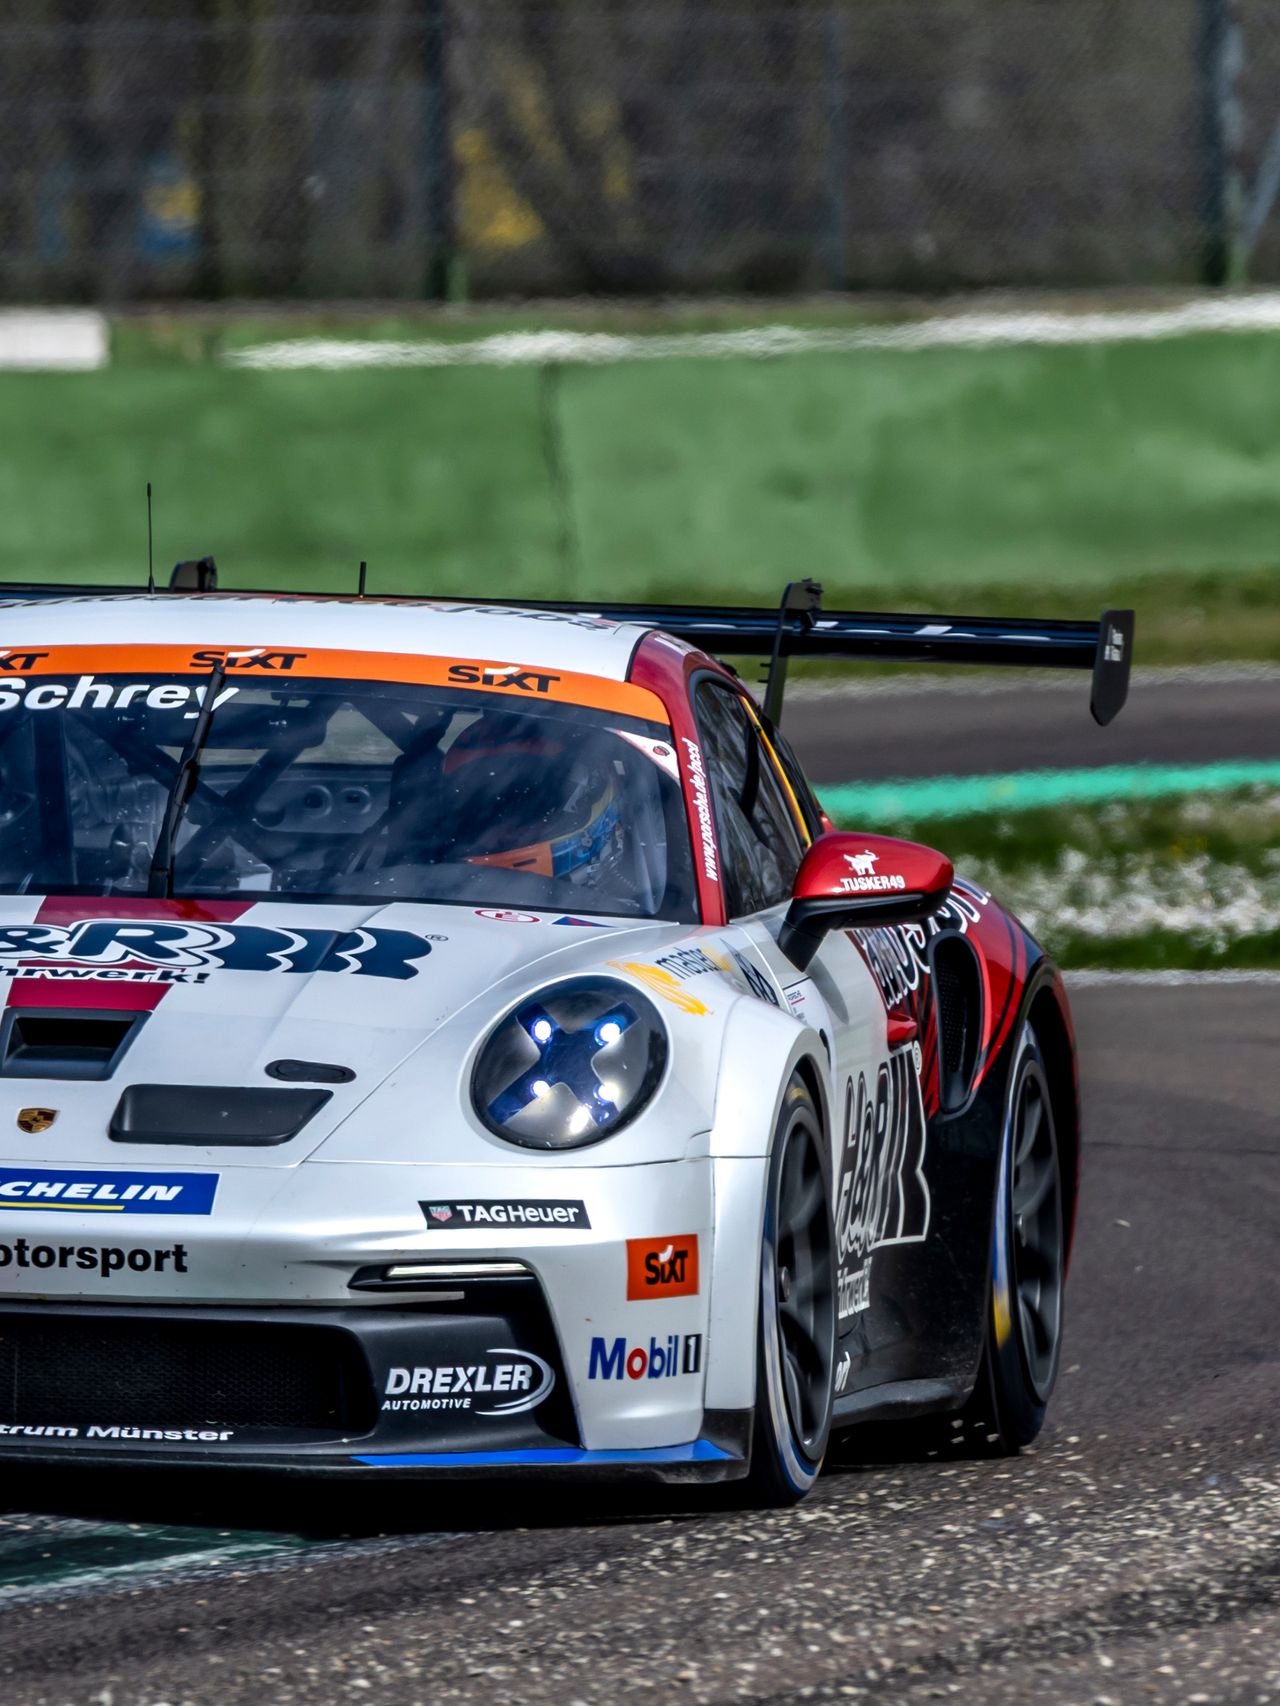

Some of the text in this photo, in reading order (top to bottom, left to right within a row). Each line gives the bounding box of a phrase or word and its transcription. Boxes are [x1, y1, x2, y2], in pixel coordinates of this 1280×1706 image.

[839, 874, 906, 892] TUSKER49
[587, 1335, 679, 1381] Mobil
[384, 1363, 533, 1395] DREXLER
[381, 1398, 472, 1411] AUTOMOTIVE
[86, 1425, 236, 1442] Münster
